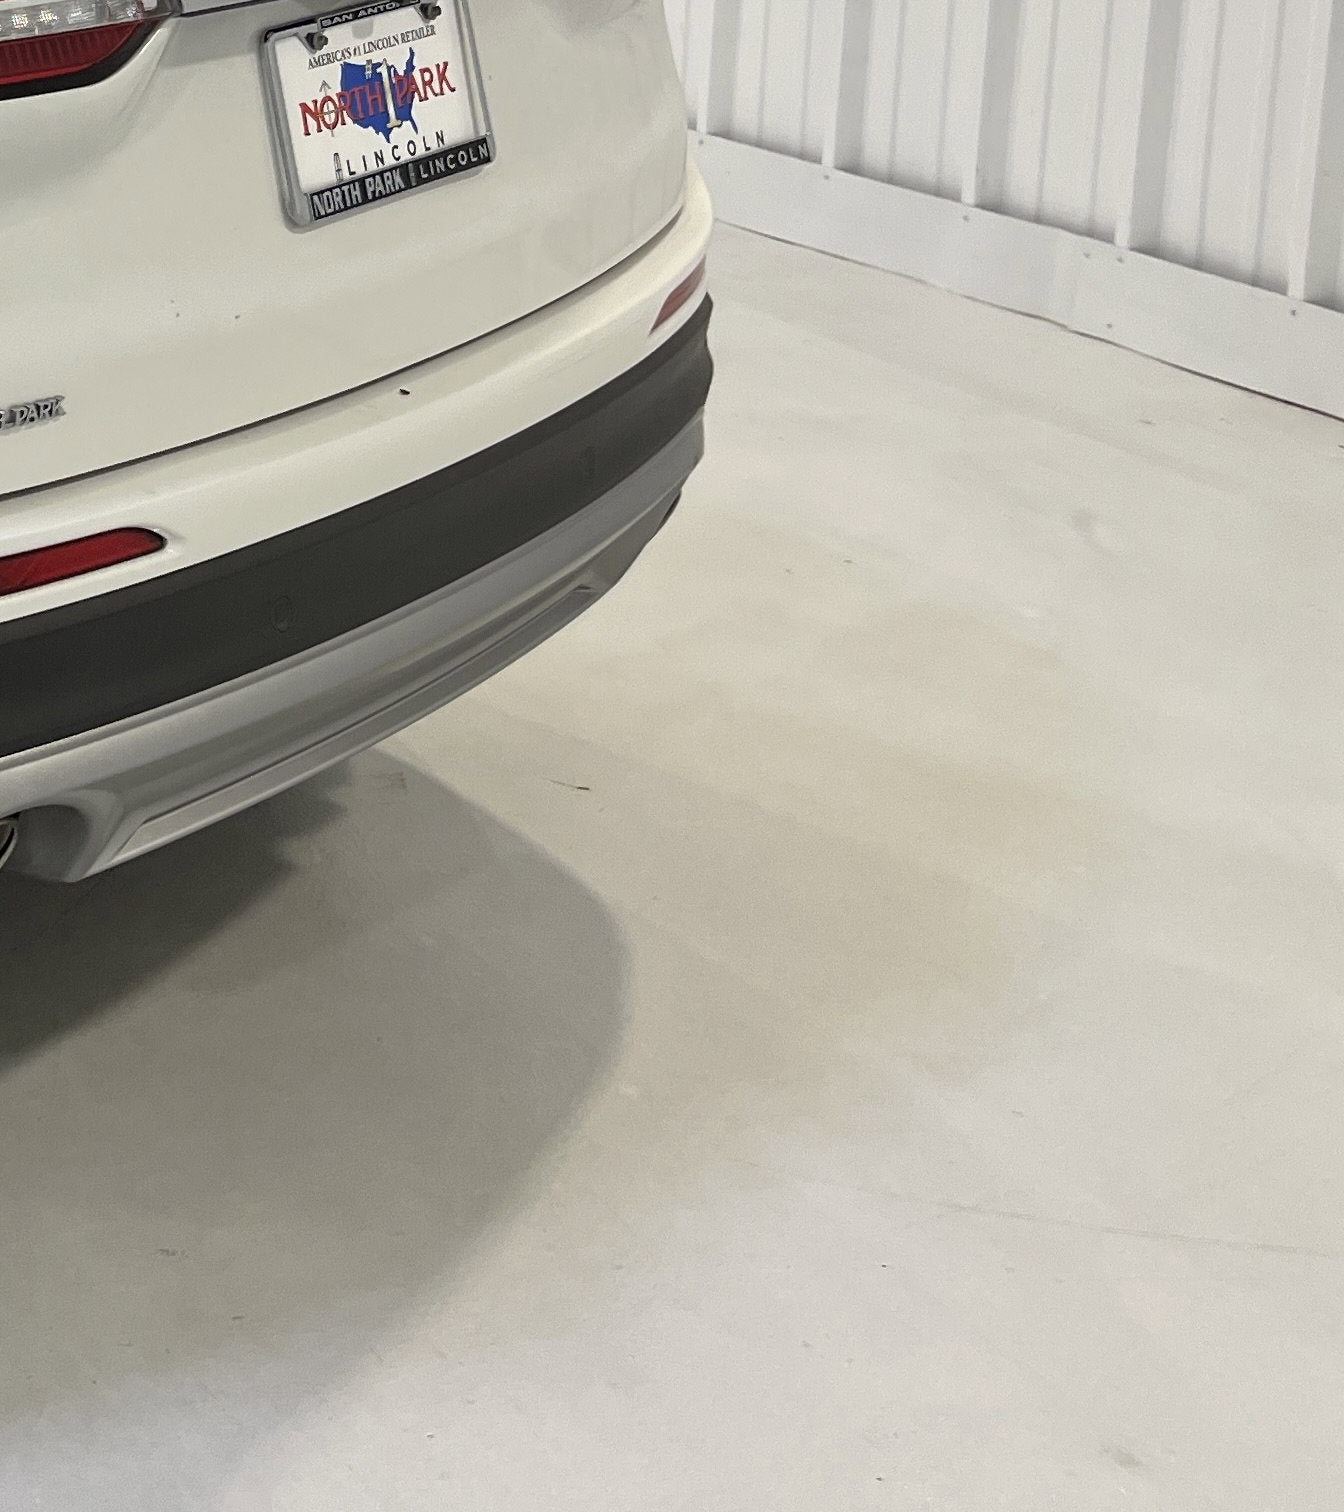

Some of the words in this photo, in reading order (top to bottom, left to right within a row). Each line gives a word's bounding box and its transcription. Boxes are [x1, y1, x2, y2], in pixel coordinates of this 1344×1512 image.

[321, 14, 353, 27] SAN
[308, 46, 351, 70] AMERICA'S
[362, 33, 400, 55] LINCOLN
[401, 24, 436, 44] RETAILER
[299, 79, 386, 137] NORTH
[393, 61, 456, 107] PARK
[346, 130, 445, 176] LINCOLN
[312, 184, 362, 218] NORTH
[364, 169, 405, 200] PARK
[419, 142, 489, 179] LINCOLN
[15, 396, 65, 427] PARK
